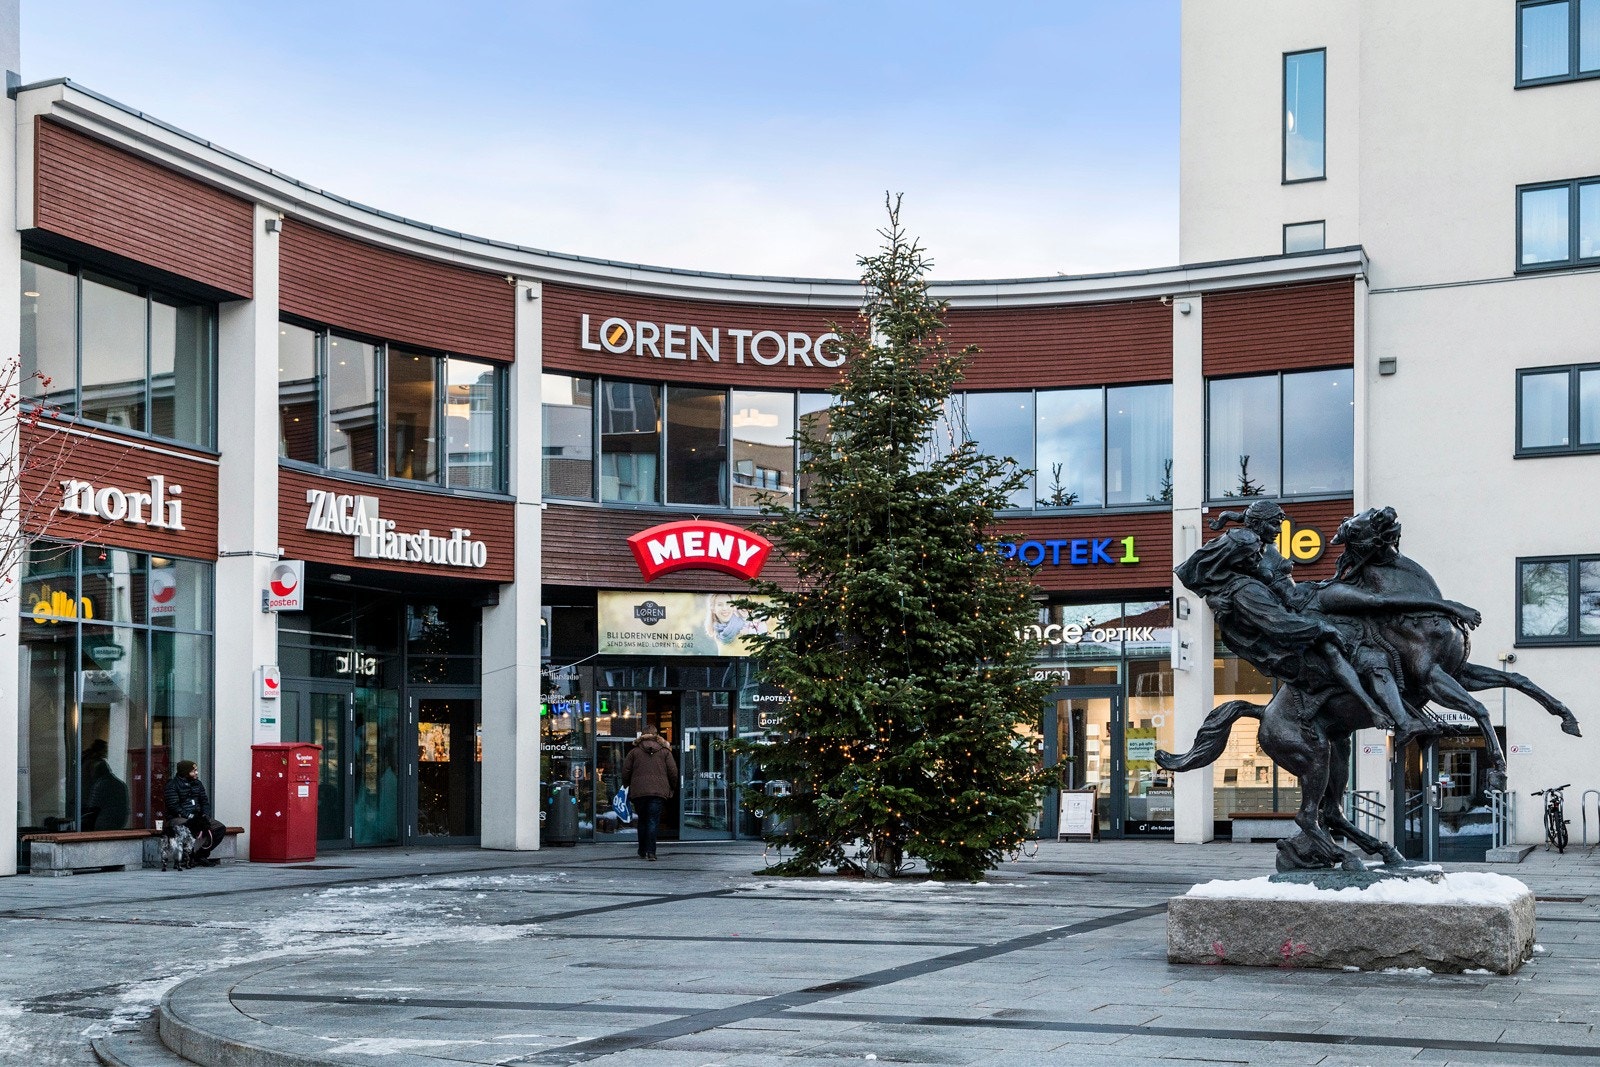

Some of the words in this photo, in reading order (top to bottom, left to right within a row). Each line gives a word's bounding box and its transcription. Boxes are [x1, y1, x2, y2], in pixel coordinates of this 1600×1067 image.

[581, 313, 720, 362] LØREN
[728, 328, 847, 368] TORG
[59, 475, 186, 530] norli
[306, 489, 371, 537] ZAGA
[369, 517, 488, 568] Hårstudio
[646, 531, 762, 566] MENY
[976, 537, 1115, 567] POTEK
[1119, 535, 1140, 563] 1
[269, 598, 298, 608] posten
[636, 608, 664, 616] LØREN
[1092, 627, 1154, 642] OPTIKK
